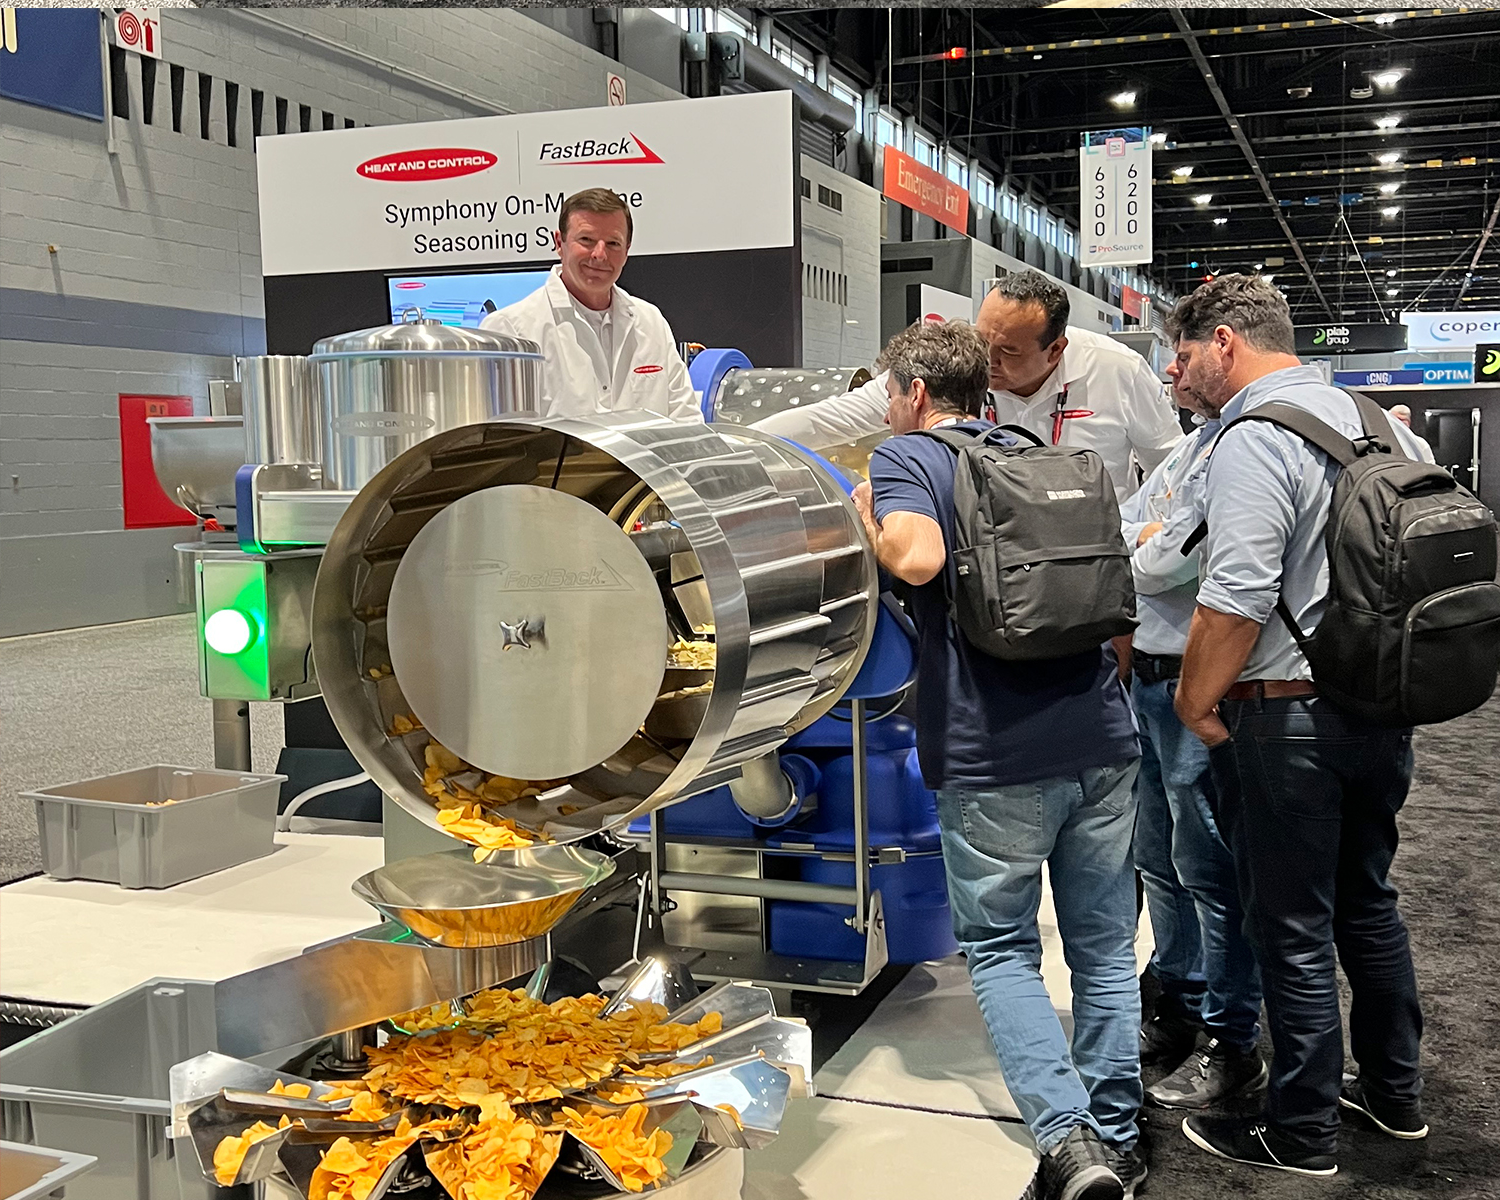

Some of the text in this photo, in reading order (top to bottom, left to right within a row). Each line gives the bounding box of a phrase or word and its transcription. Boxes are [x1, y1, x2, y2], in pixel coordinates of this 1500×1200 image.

[539, 137, 630, 161] FastBack
[364, 156, 490, 174] HEAT AND CONTROL
[898, 159, 943, 208] Emergency
[384, 192, 643, 228] Symphony On-Mne
[413, 229, 528, 254] Seasoning
[1097, 243, 1144, 254] ProSource
[1326, 337, 1350, 346] group
[1369, 372, 1389, 383] CNG
[1425, 370, 1471, 381] OPTIM
[504, 566, 602, 589] FastBack
